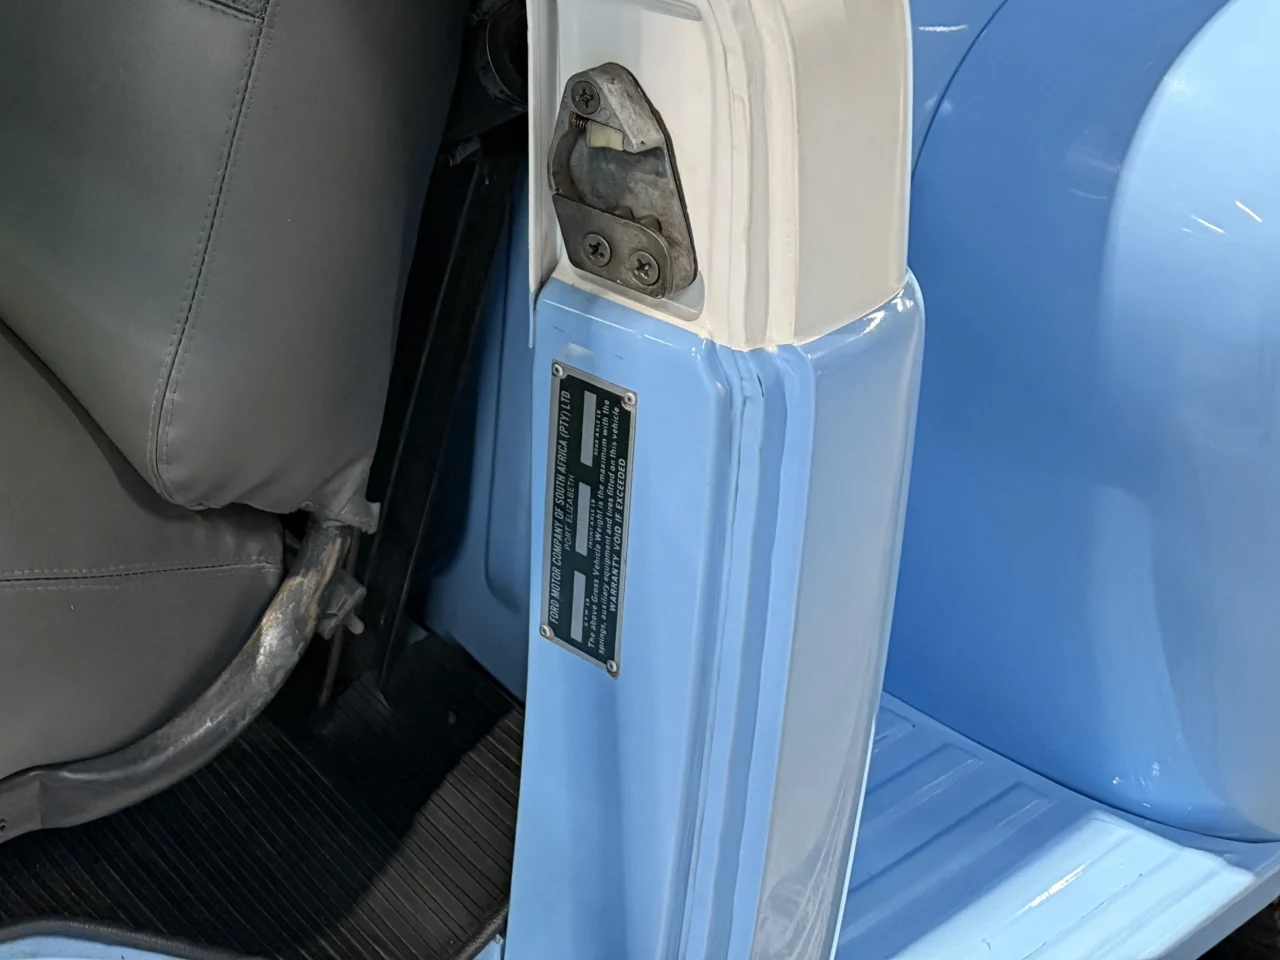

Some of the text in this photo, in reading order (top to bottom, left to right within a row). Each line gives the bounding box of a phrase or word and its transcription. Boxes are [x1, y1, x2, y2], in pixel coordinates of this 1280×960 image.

[602, 399, 610, 415] the
[559, 411, 571, 438] (PTY)
[556, 440, 568, 474] AFRICA
[610, 442, 618, 459] this
[609, 460, 616, 472] on
[555, 474, 566, 506] SOUTH
[597, 484, 605, 499] the
[607, 472, 615, 496] fitted
[554, 506, 564, 520] OF
[564, 474, 575, 551] PORT ELIZABETH
[606, 497, 614, 517] tires
[594, 509, 604, 542] Weight
[605, 517, 613, 535] and
[609, 458, 626, 612] WARRANTY VOID IF EXCEEDED
[552, 520, 564, 566] COMPANY
[592, 544, 601, 576] Vehicle
[603, 535, 611, 582] equipment
[550, 566, 562, 599] MOTOR
[591, 579, 600, 603] Gross
[549, 600, 560, 624] FORD
[601, 583, 610, 620] auxiliary
[590, 605, 598, 630] above
[588, 632, 596, 648] The
[598, 622, 607, 655] springs,
